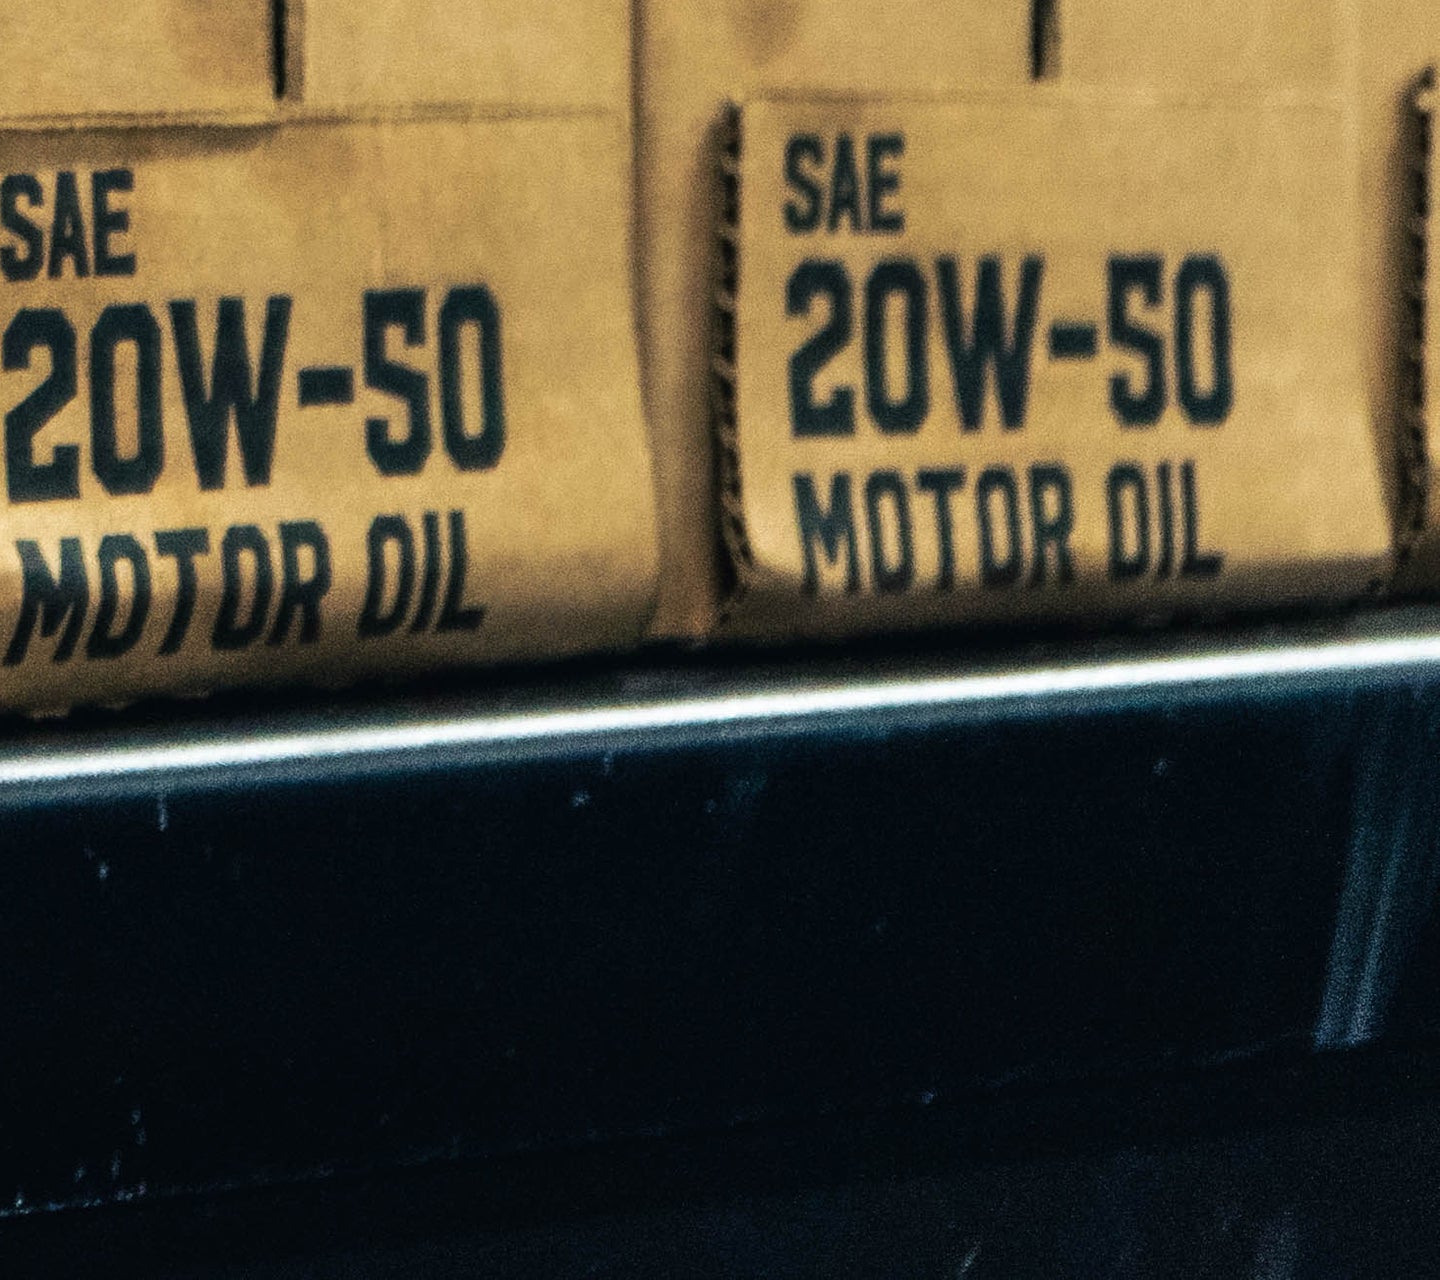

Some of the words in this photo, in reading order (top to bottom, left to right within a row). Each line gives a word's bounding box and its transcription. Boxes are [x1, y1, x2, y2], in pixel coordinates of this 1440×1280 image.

[784, 133, 905, 237] SAE
[0, 282, 507, 504] 20W-50
[784, 252, 1235, 439] 20W-50
[2, 519, 333, 667] MOTOR
[356, 508, 488, 639] OIL
[791, 461, 1077, 595] MOTOR
[1105, 457, 1226, 581] OIL
